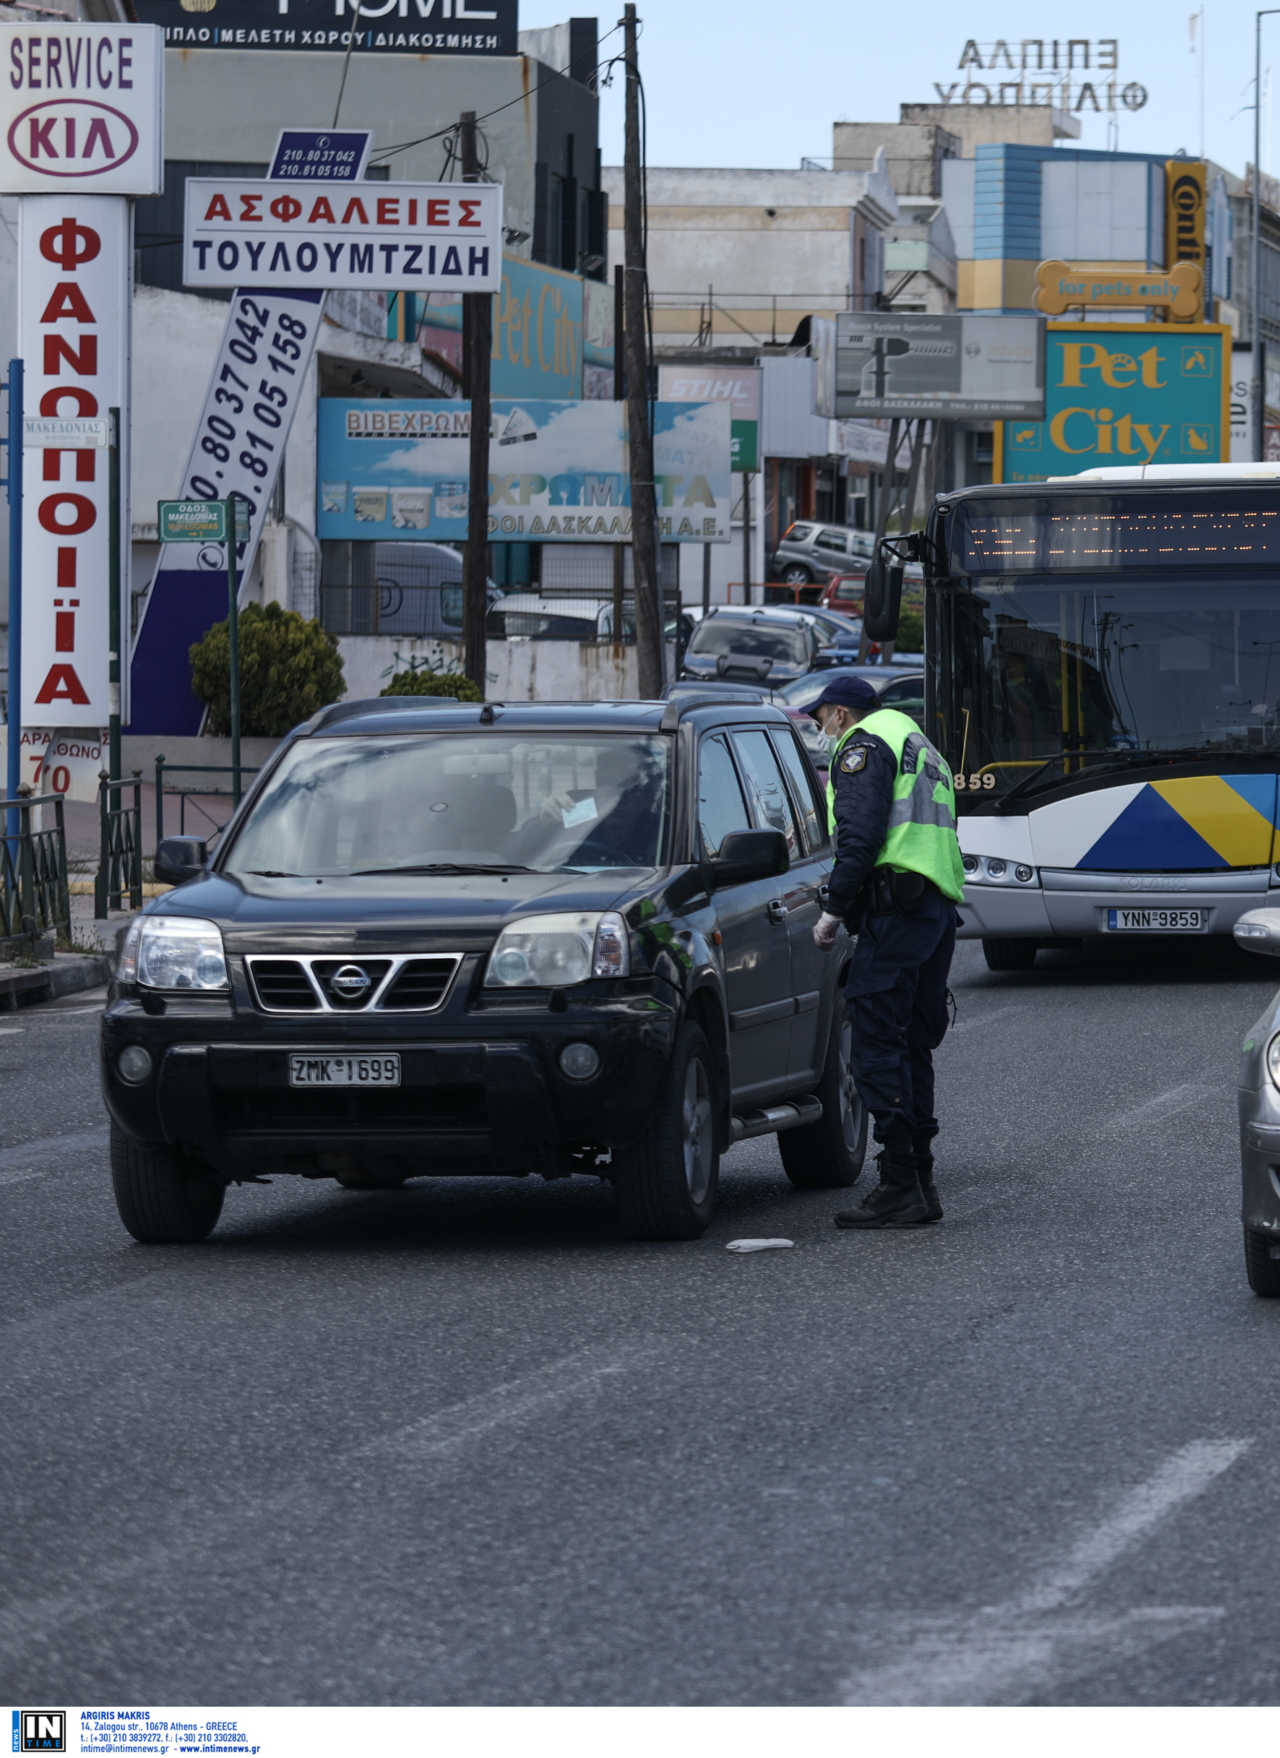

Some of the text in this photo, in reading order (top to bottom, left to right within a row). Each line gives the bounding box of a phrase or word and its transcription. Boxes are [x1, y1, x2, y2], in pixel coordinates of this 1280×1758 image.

[166, 28, 498, 49] ΙΠΛΟ ΜΕΛΕΤΗ ΧΩΡΟΥ ΔΙΑΚΟΣΜΗΣΗ
[10, 37, 133, 90] SERVICE
[29, 118, 116, 159] KIA
[204, 193, 483, 228] ΑΣΦΑΛΕΙΕΣ
[192, 240, 490, 276] ΤΟΥΛΟΥΜΤΖΙΔΗ
[1058, 278, 1181, 302] for pets only
[1055, 341, 1168, 389] Pet
[669, 379, 750, 399] STIHL
[1050, 406, 1172, 465] City
[487, 515, 525, 535] ΦΟΙ
[529, 515, 674, 536] ΔΑΣΚΑΛΗ
[29, 755, 71, 793] 70
